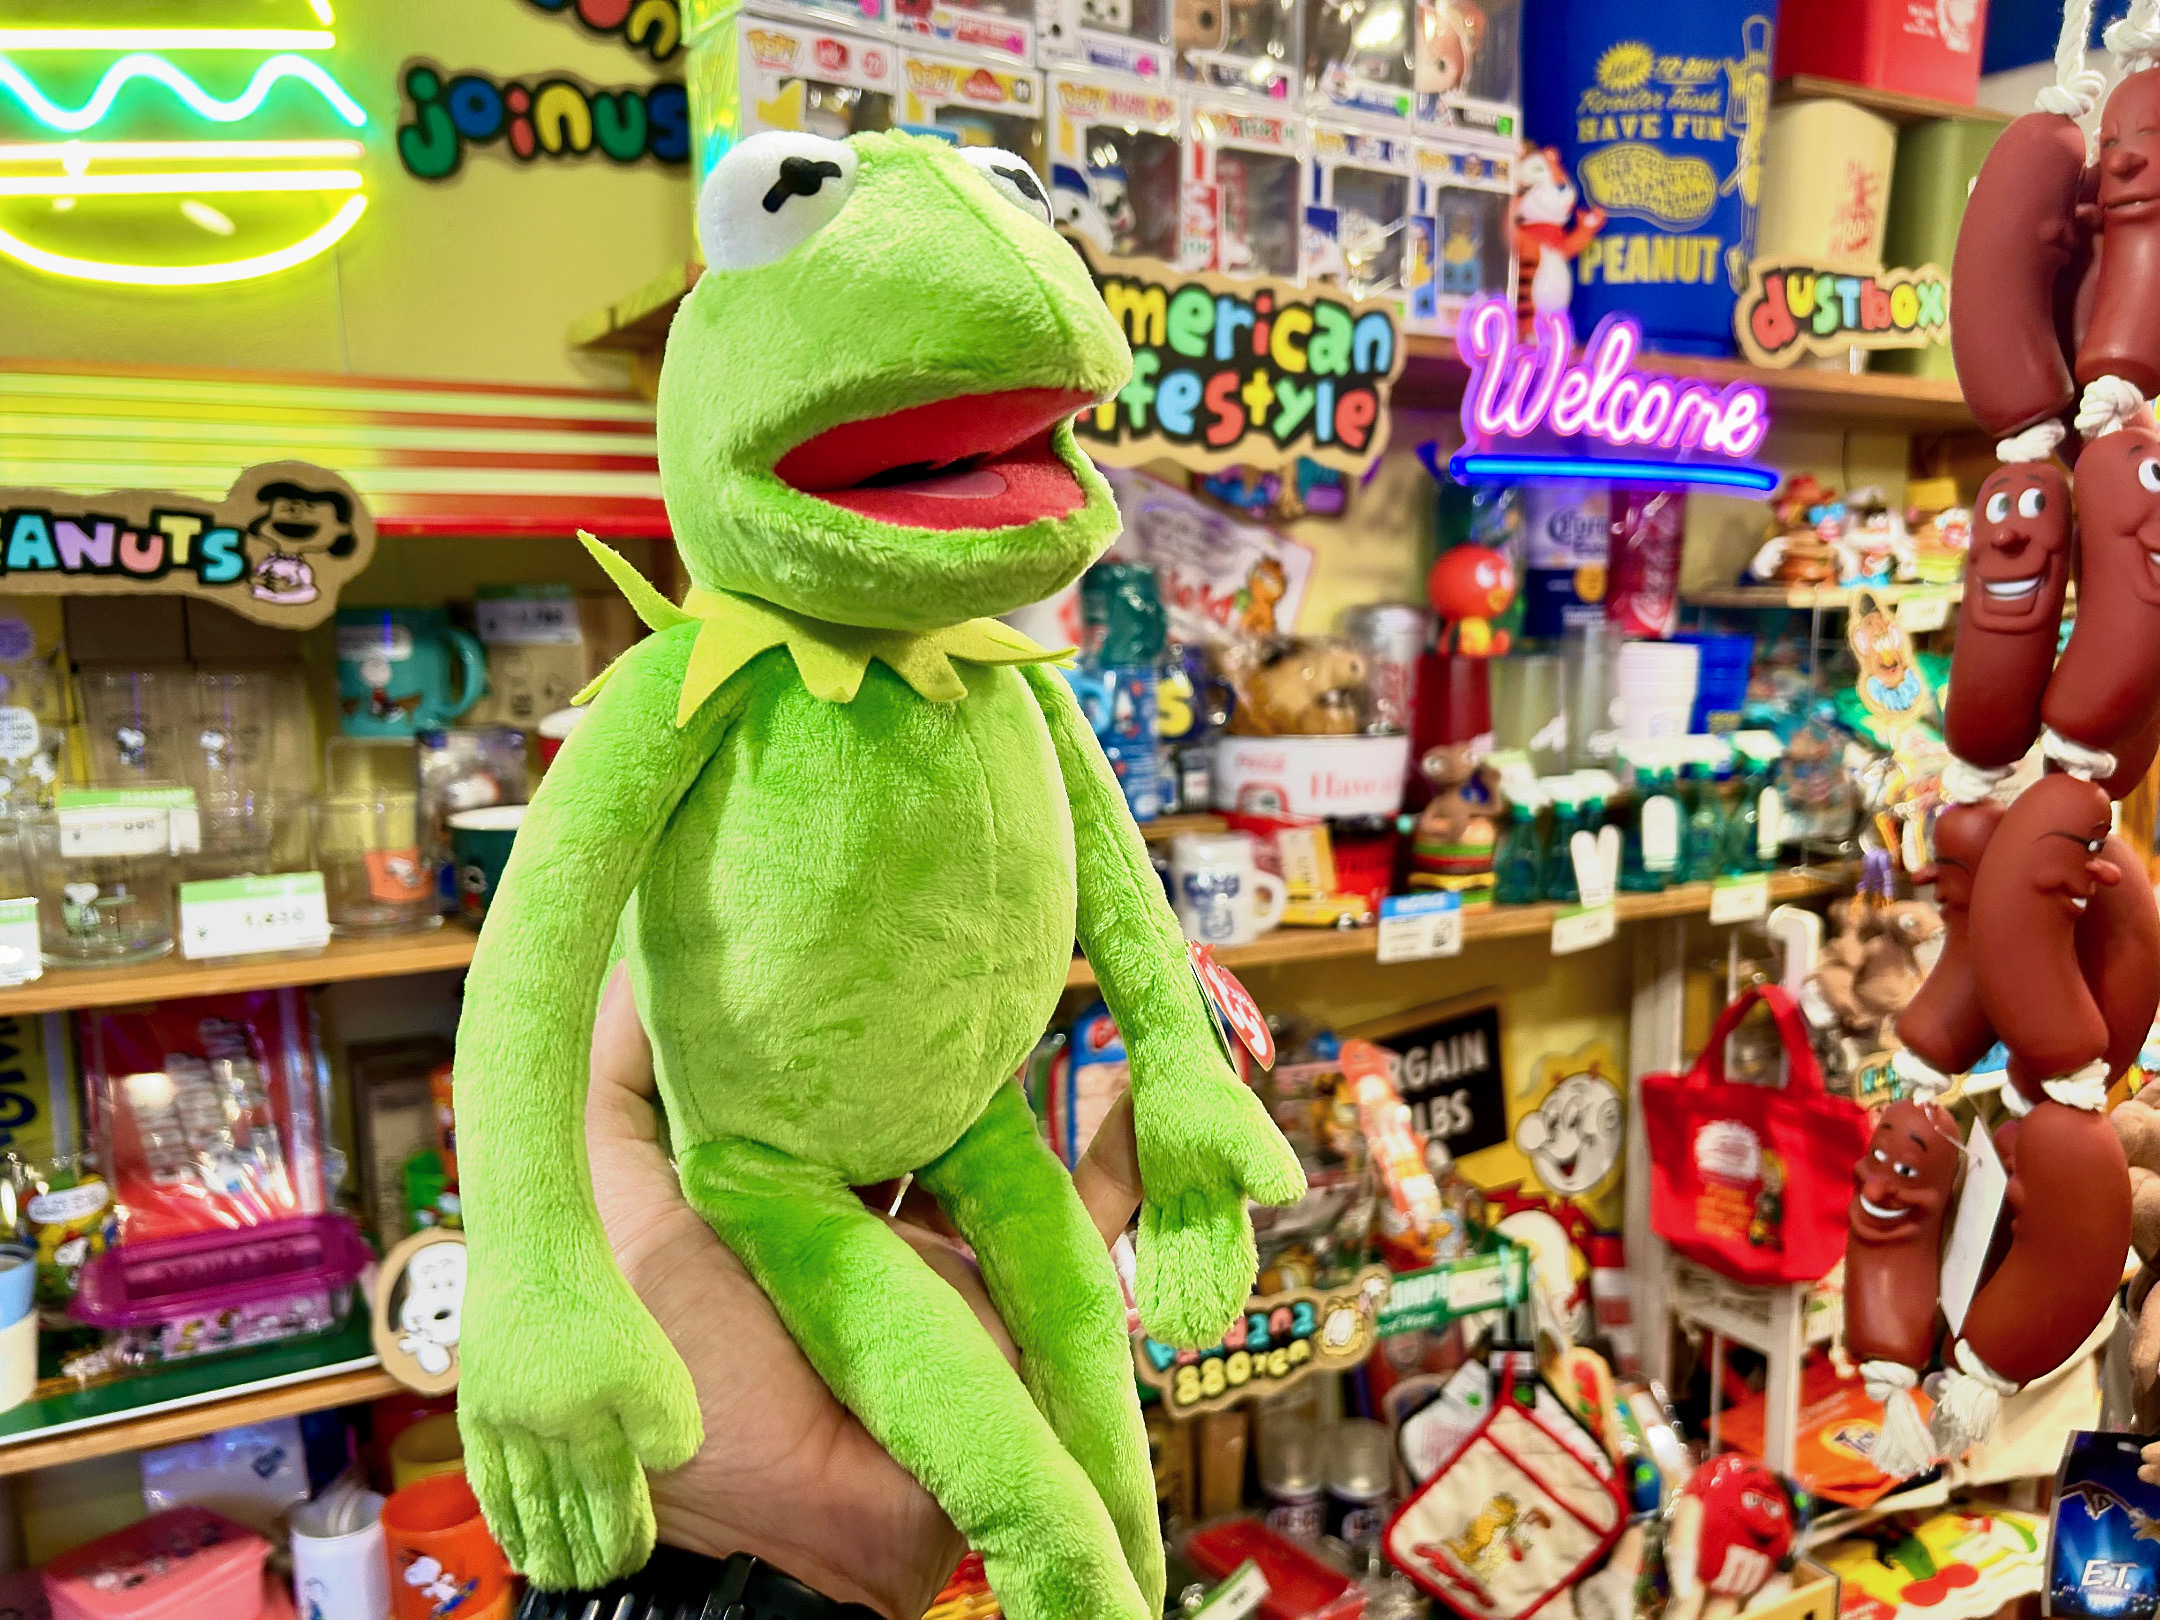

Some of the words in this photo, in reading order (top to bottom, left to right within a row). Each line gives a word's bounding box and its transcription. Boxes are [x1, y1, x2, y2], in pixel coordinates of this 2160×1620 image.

[1578, 115, 1660, 142] HAVE
[1671, 114, 1724, 141] FUN
[1578, 236, 1720, 284] PEANUT
[1103, 278, 1393, 376] merican
[1474, 297, 1769, 457] Welcome
[0, 514, 243, 582] ANUTS
[2081, 1559, 2139, 1590] E.T.
